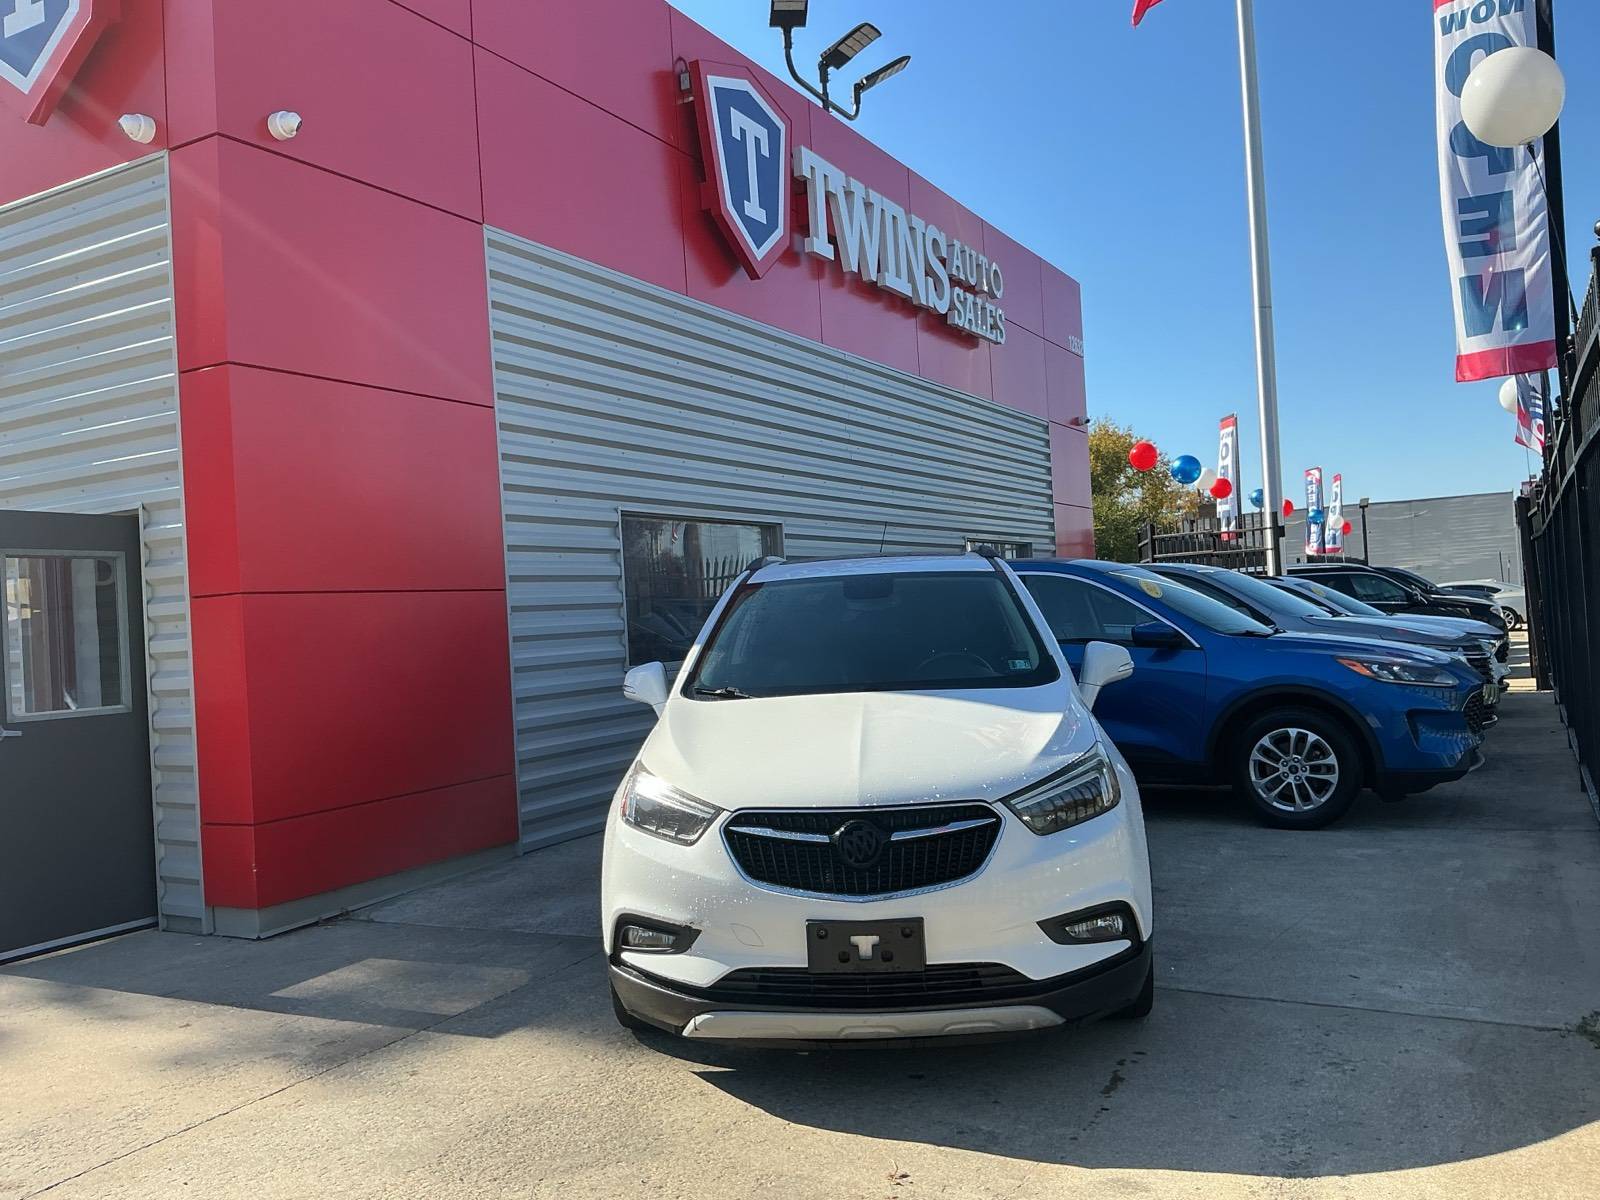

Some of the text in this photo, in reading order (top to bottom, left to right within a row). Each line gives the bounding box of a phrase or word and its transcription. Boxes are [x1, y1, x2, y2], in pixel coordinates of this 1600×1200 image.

[730, 106, 770, 225] T
[797, 144, 950, 315] TWINS
[952, 239, 1003, 299] AUTO
[952, 287, 1006, 345] SALES
